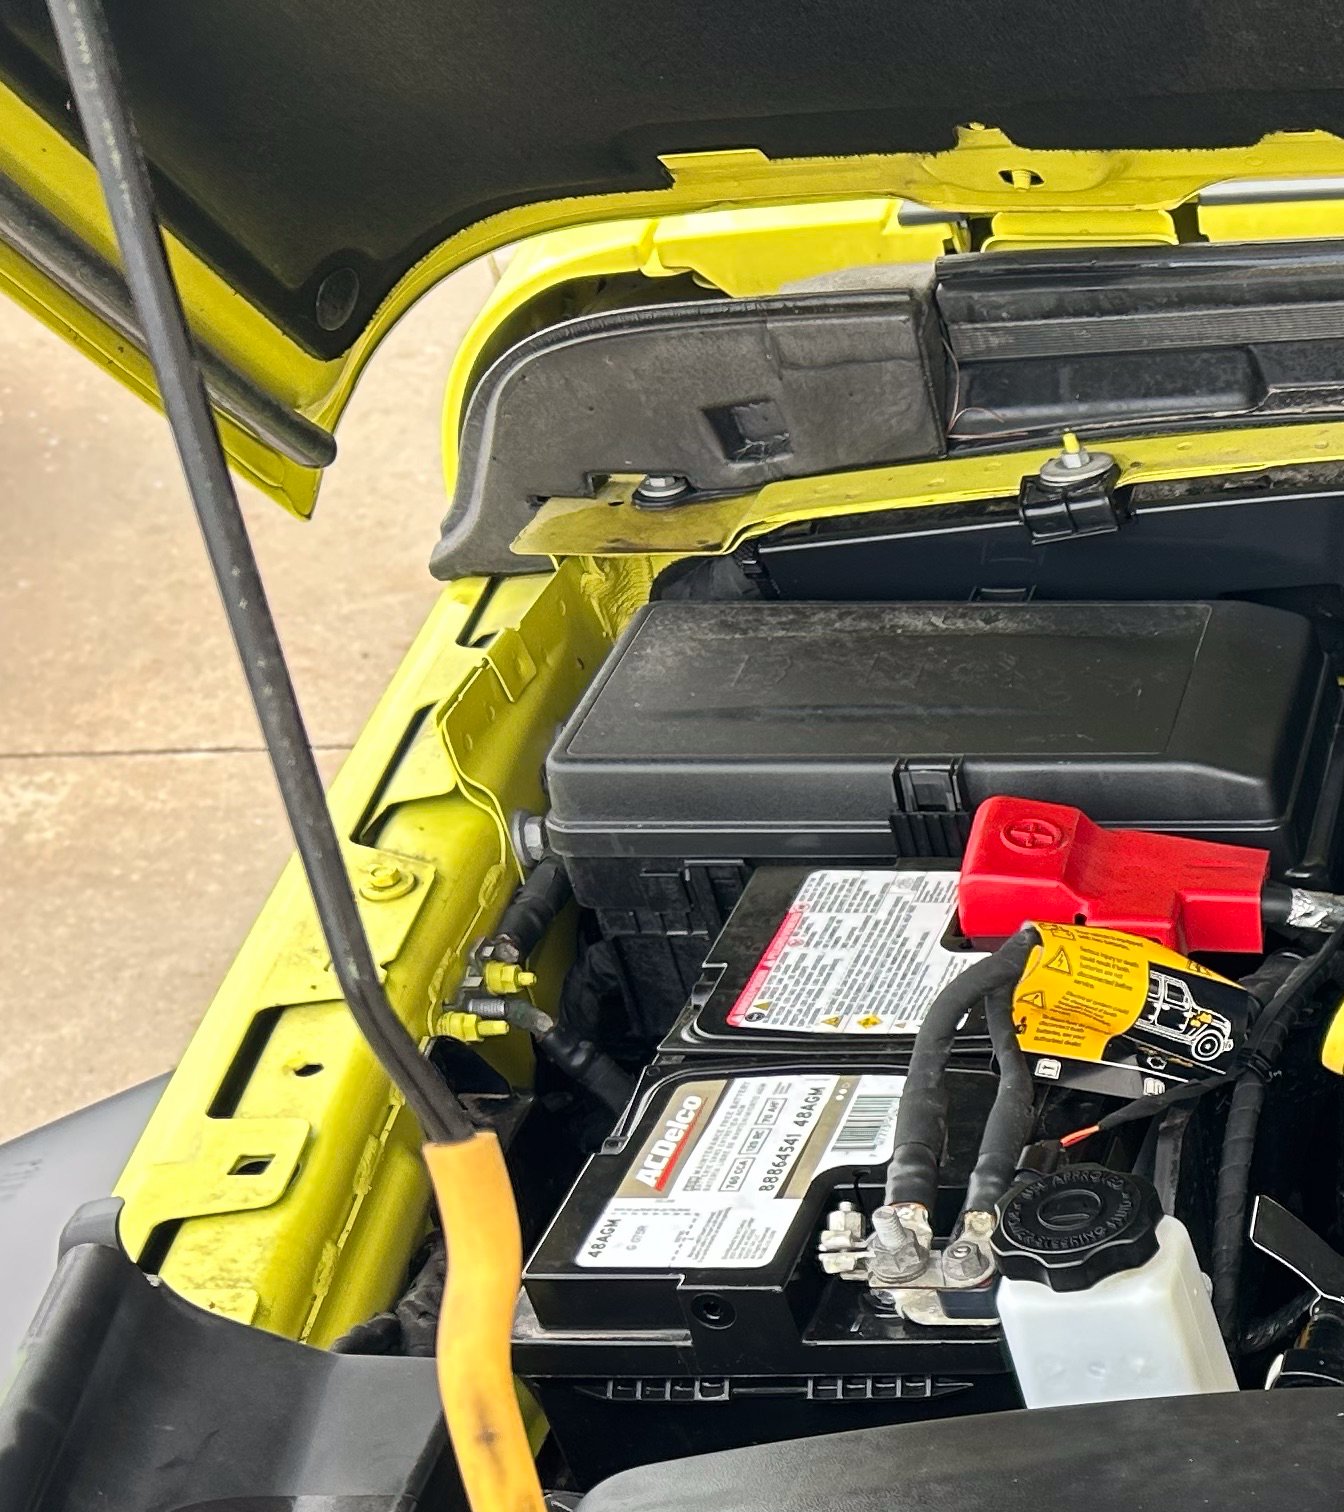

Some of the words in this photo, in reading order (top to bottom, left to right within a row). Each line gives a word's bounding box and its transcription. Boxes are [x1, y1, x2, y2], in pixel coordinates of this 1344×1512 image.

[635, 1095, 702, 1188] ACDelco
[759, 1134, 802, 1191] 88864541
[793, 1087, 827, 1127] 48AGM
[588, 1218, 621, 1258] 48AGM
